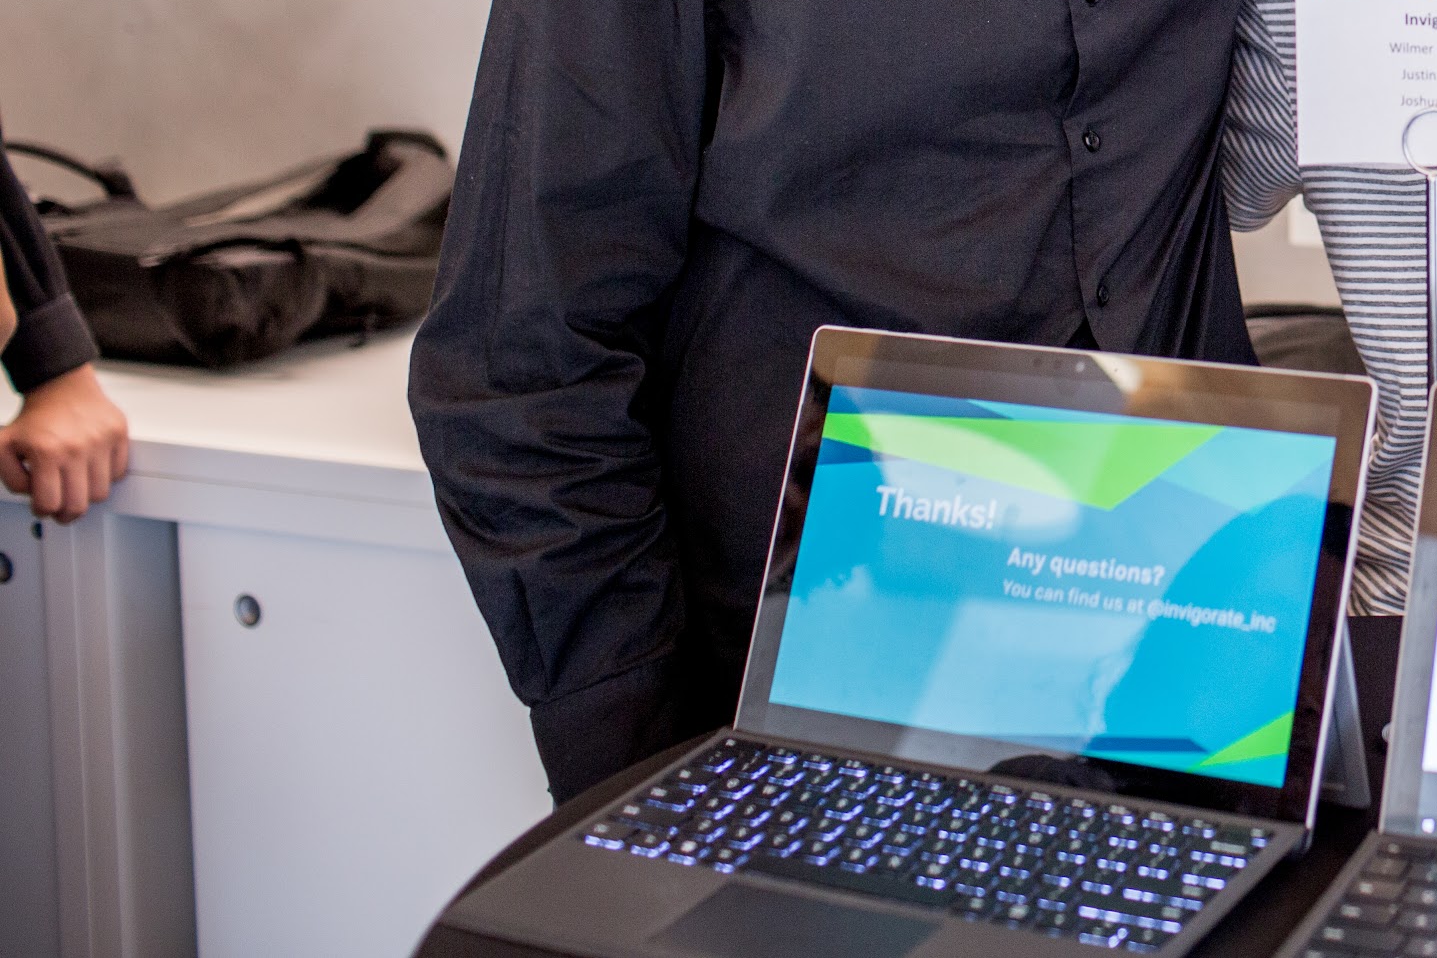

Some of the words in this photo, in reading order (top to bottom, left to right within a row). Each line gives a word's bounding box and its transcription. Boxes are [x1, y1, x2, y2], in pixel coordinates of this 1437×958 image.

[1389, 42, 1434, 55] Wilmer
[1402, 69, 1437, 81] Justin
[876, 485, 998, 530] Thanks!
[1007, 546, 1046, 575] Any
[1050, 554, 1166, 586] questions?
[1003, 578, 1031, 598] You
[1034, 586, 1064, 603] can
[1067, 587, 1100, 608] find
[1103, 596, 1124, 611] us
[1127, 598, 1144, 614] at
[1147, 597, 1277, 634] @invigorate_inc
